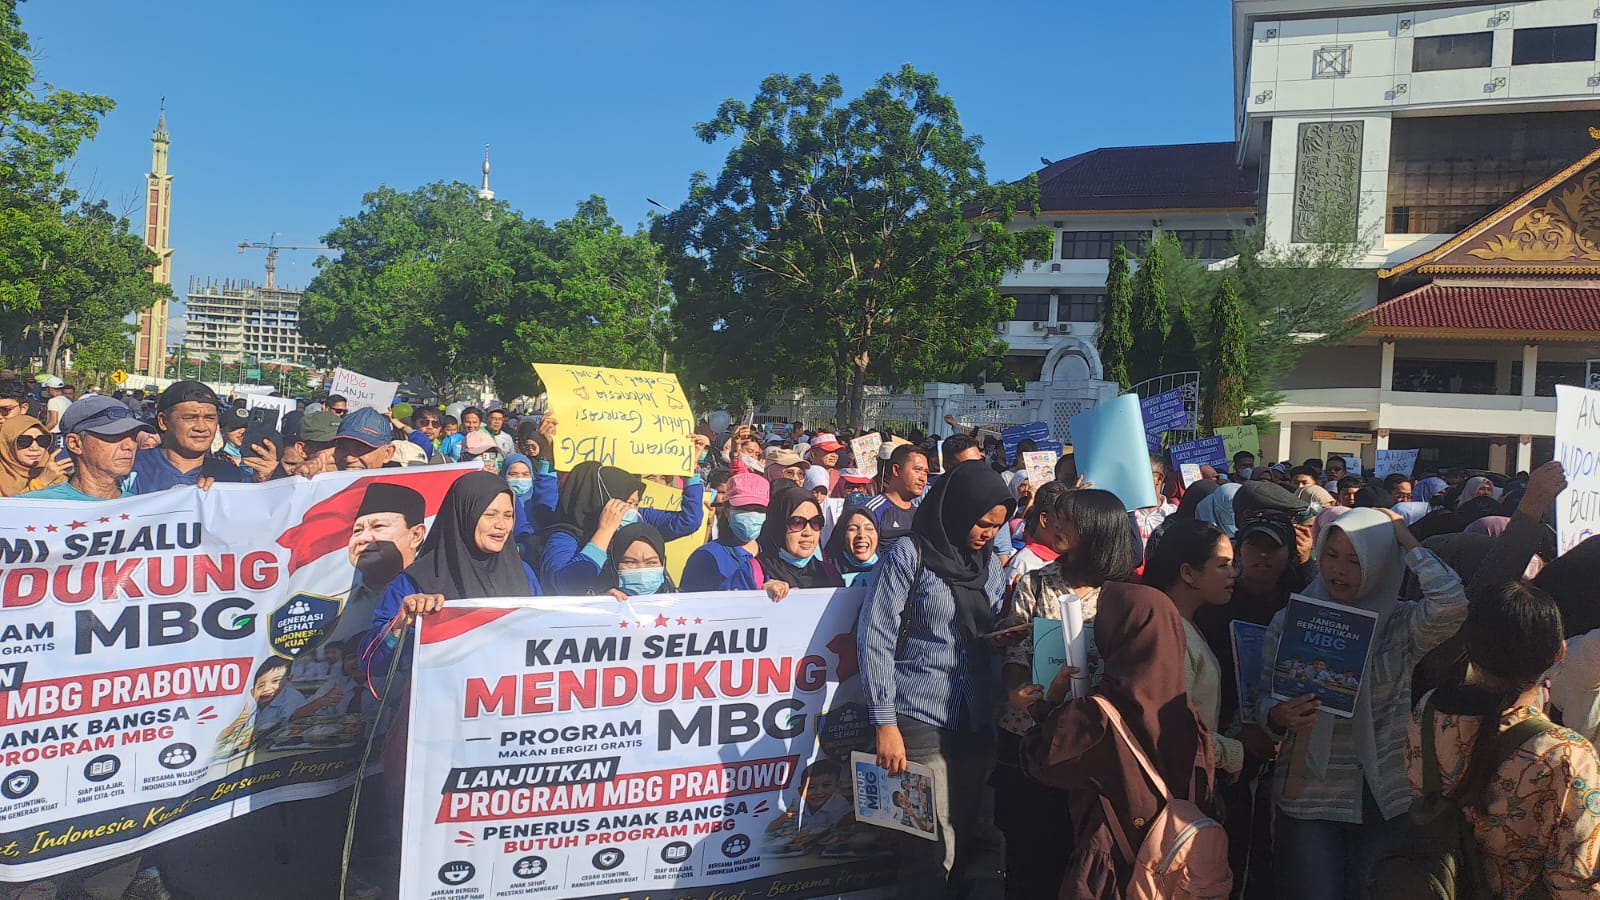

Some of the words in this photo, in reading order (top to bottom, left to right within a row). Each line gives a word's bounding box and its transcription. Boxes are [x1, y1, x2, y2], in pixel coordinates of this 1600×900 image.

[335, 382, 376, 399] LANJUT
[339, 370, 368, 388] MBG
[595, 391, 659, 408] Indonesia
[560, 436, 616, 466] MBG
[630, 439, 693, 472] Program
[62, 522, 202, 560] SELALU
[0, 551, 279, 608] DUKUNG
[75, 597, 258, 655] MBG
[277, 613, 324, 628] GENERASI
[283, 621, 315, 634] SEHAT
[1296, 620, 1361, 640] BERHENTIKAN
[1309, 617, 1351, 631] JANGAN
[2, 643, 55, 655] GRATIS
[274, 629, 324, 645] INDONESIA
[284, 638, 310, 648] KUAT
[525, 636, 631, 667] KAMI
[642, 627, 768, 659] SELALU
[1303, 631, 1347, 651] MBG
[6, 682, 84, 719] MBG
[91, 663, 241, 707] PRABOWO
[464, 654, 828, 718] MENDUKUNG
[1, 722, 79, 750] ANAK
[88, 706, 191, 735] BANGSA
[121, 725, 175, 746] MBG
[500, 719, 642, 747] PROGRAM
[657, 698, 807, 751] MBG
[498, 749, 548, 759] MAKAN
[551, 743, 598, 756] BERGIZI
[600, 739, 643, 751] GRATIS
[449, 783, 601, 818] PROGRAM
[602, 776, 663, 806] MBG
[670, 761, 788, 797] PRABOWO
[456, 762, 612, 789] LANJUTKAN
[856, 770, 868, 808] HIDUP
[93, 789, 125, 801] CITA-CITA
[865, 771, 879, 810] MBG
[28, 816, 137, 855] Indonesia
[142, 800, 190, 829] Kuat
[210, 770, 282, 801] Bersama
[483, 817, 590, 841] PENERUS
[596, 812, 650, 831] ANAK
[656, 801, 749, 825] BANGSA
[503, 836, 579, 854] BUTUH
[585, 825, 690, 847] PROGRAM
[692, 819, 737, 835] MBG
[767, 876, 831, 897] Bersama
